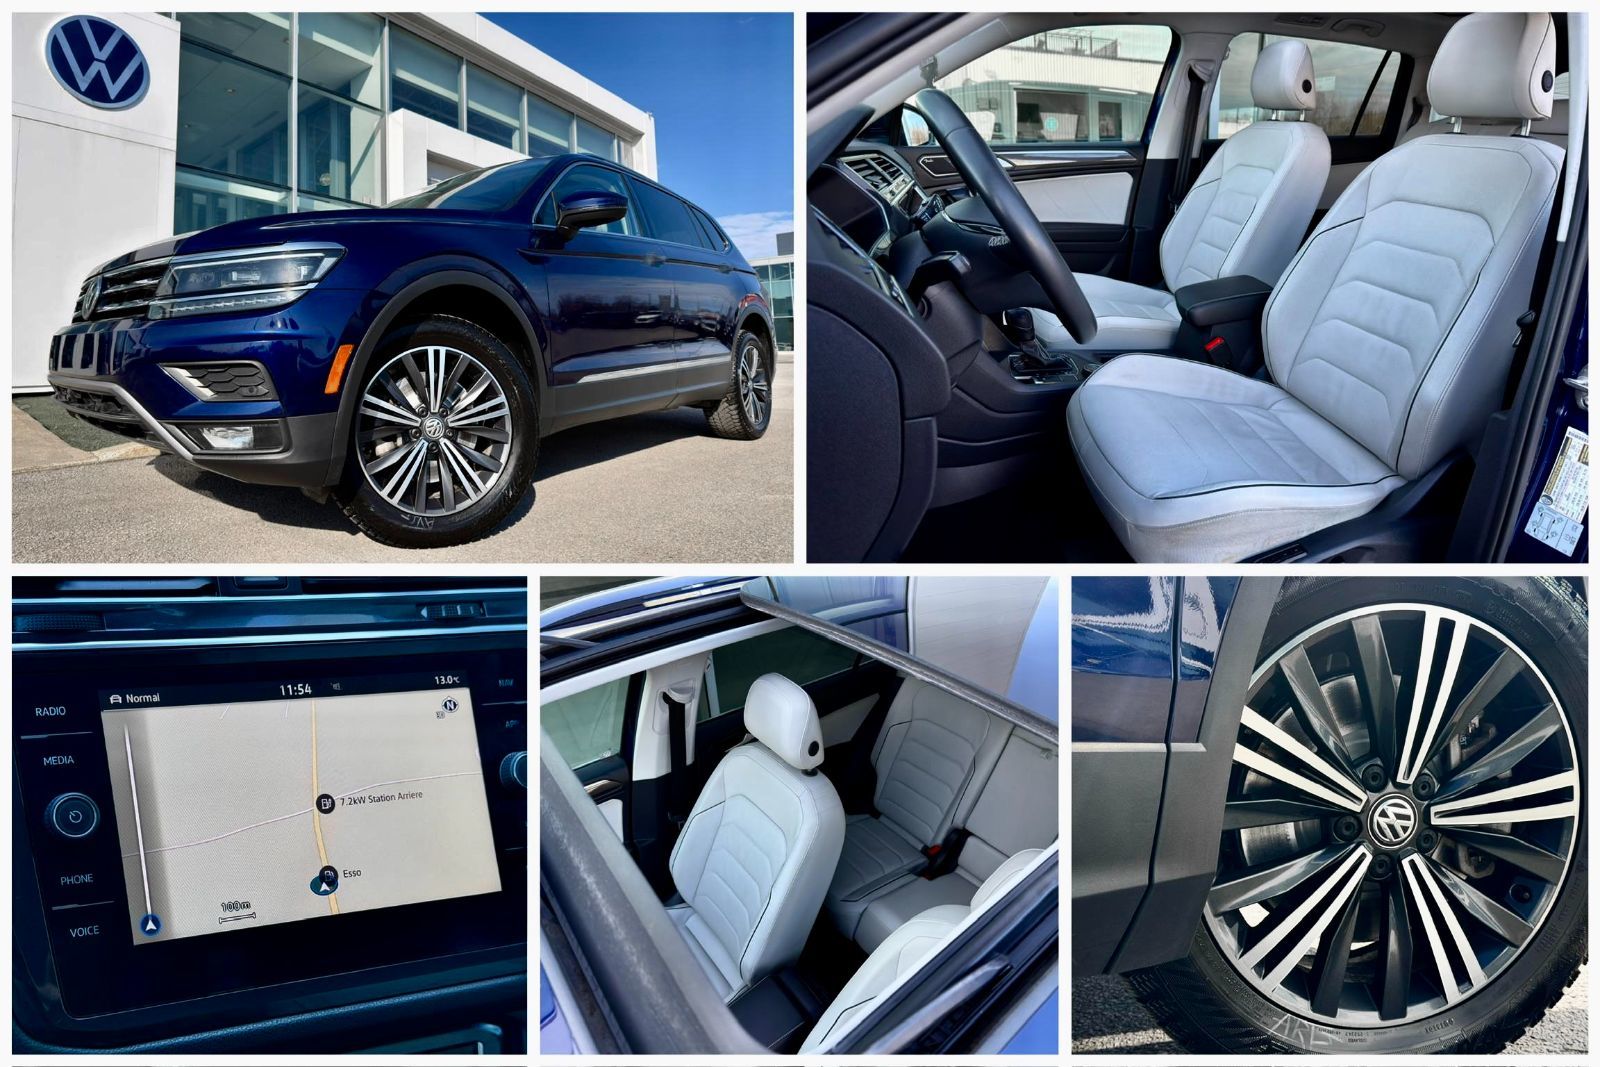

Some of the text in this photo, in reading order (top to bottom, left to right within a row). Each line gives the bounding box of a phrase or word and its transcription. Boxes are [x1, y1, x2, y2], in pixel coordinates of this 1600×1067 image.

[49, 16, 147, 105] VW
[280, 683, 313, 696] 11:54
[126, 693, 160, 704] Normal
[35, 706, 66, 717] RADIO
[43, 755, 75, 766] MEDIA
[340, 791, 423, 806] 7.2kW Station Arriere
[60, 873, 93, 886] PHONE
[342, 869, 362, 879] Esso
[221, 900, 252, 912] 100m
[69, 925, 100, 938] VOICE
